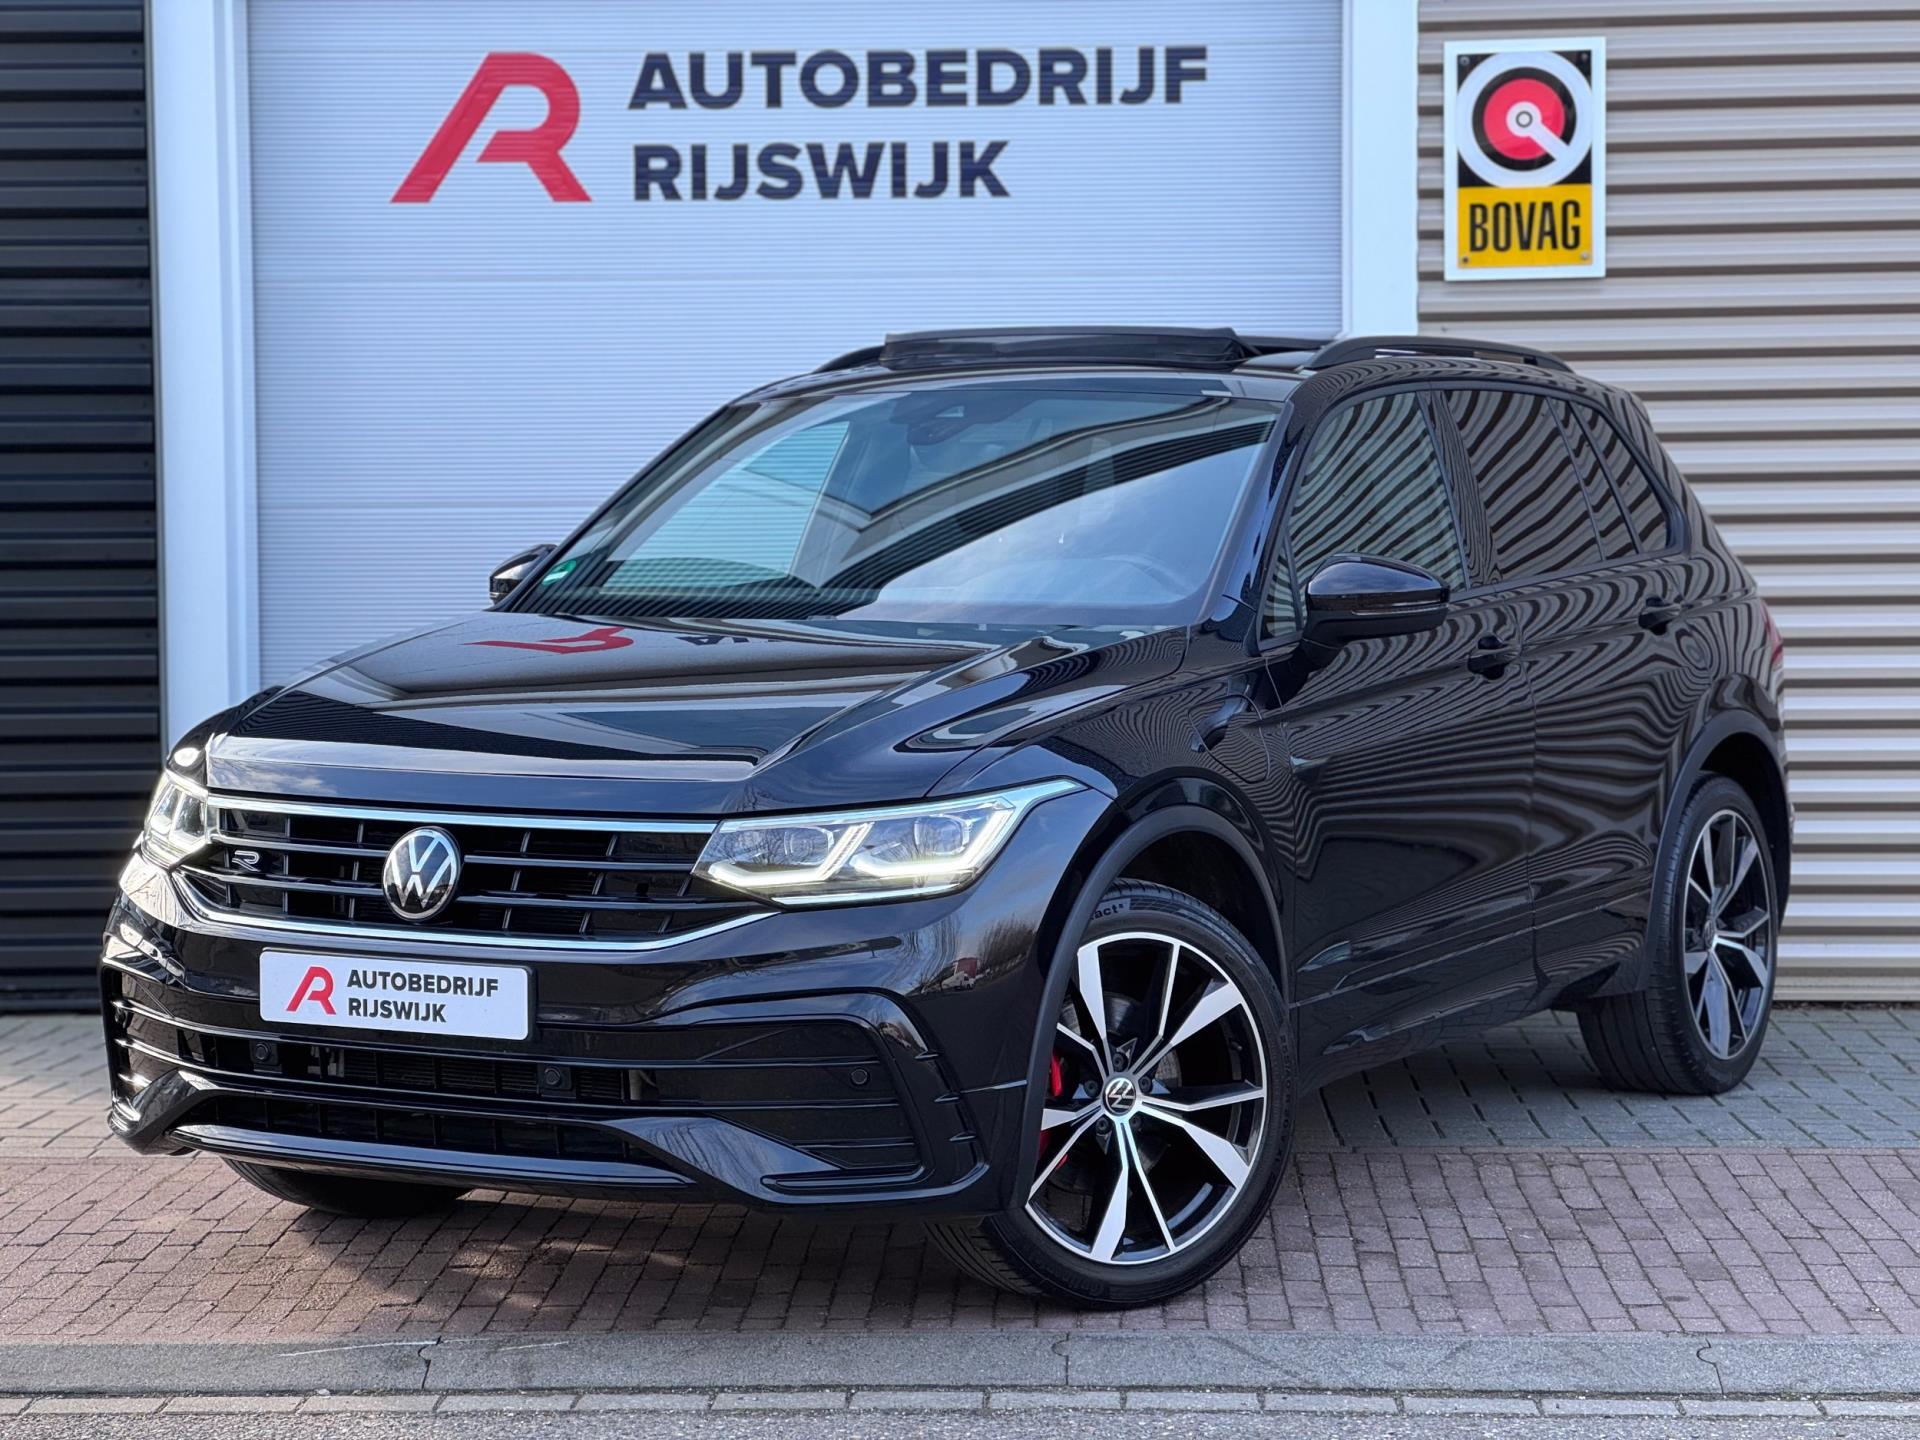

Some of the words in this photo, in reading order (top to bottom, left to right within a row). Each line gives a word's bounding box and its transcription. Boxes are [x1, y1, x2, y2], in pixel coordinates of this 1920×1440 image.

[628, 46, 1207, 109] AUTOBEDRIJF
[634, 141, 1009, 201] RIJSWIJK
[1469, 199, 1581, 253] BOVAG
[347, 969, 499, 997] AUTOBEDRIJF
[348, 997, 447, 1023] RIJSWIJK
